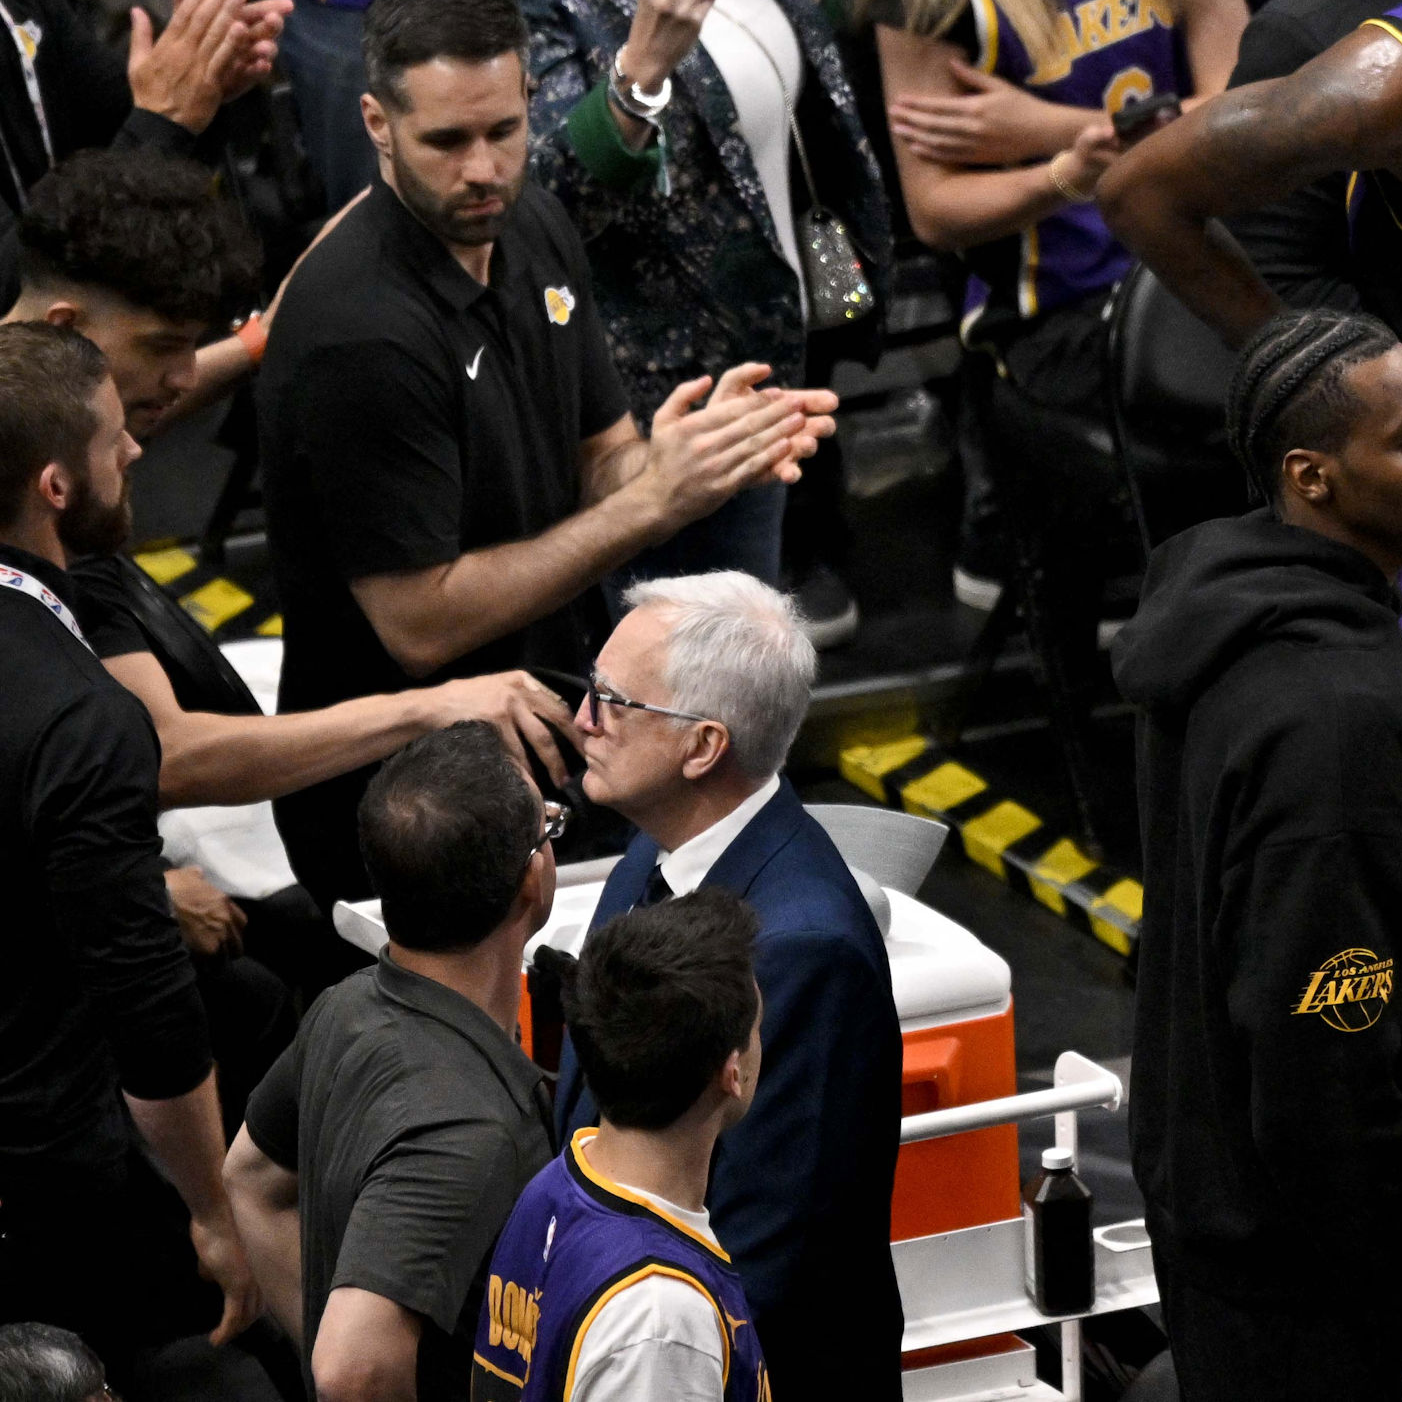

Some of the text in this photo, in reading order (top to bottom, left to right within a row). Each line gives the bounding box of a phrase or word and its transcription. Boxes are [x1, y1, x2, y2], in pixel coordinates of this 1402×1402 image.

[1333, 958, 1394, 979] LOS ANGELES
[1290, 968, 1394, 1016] LAKERS
